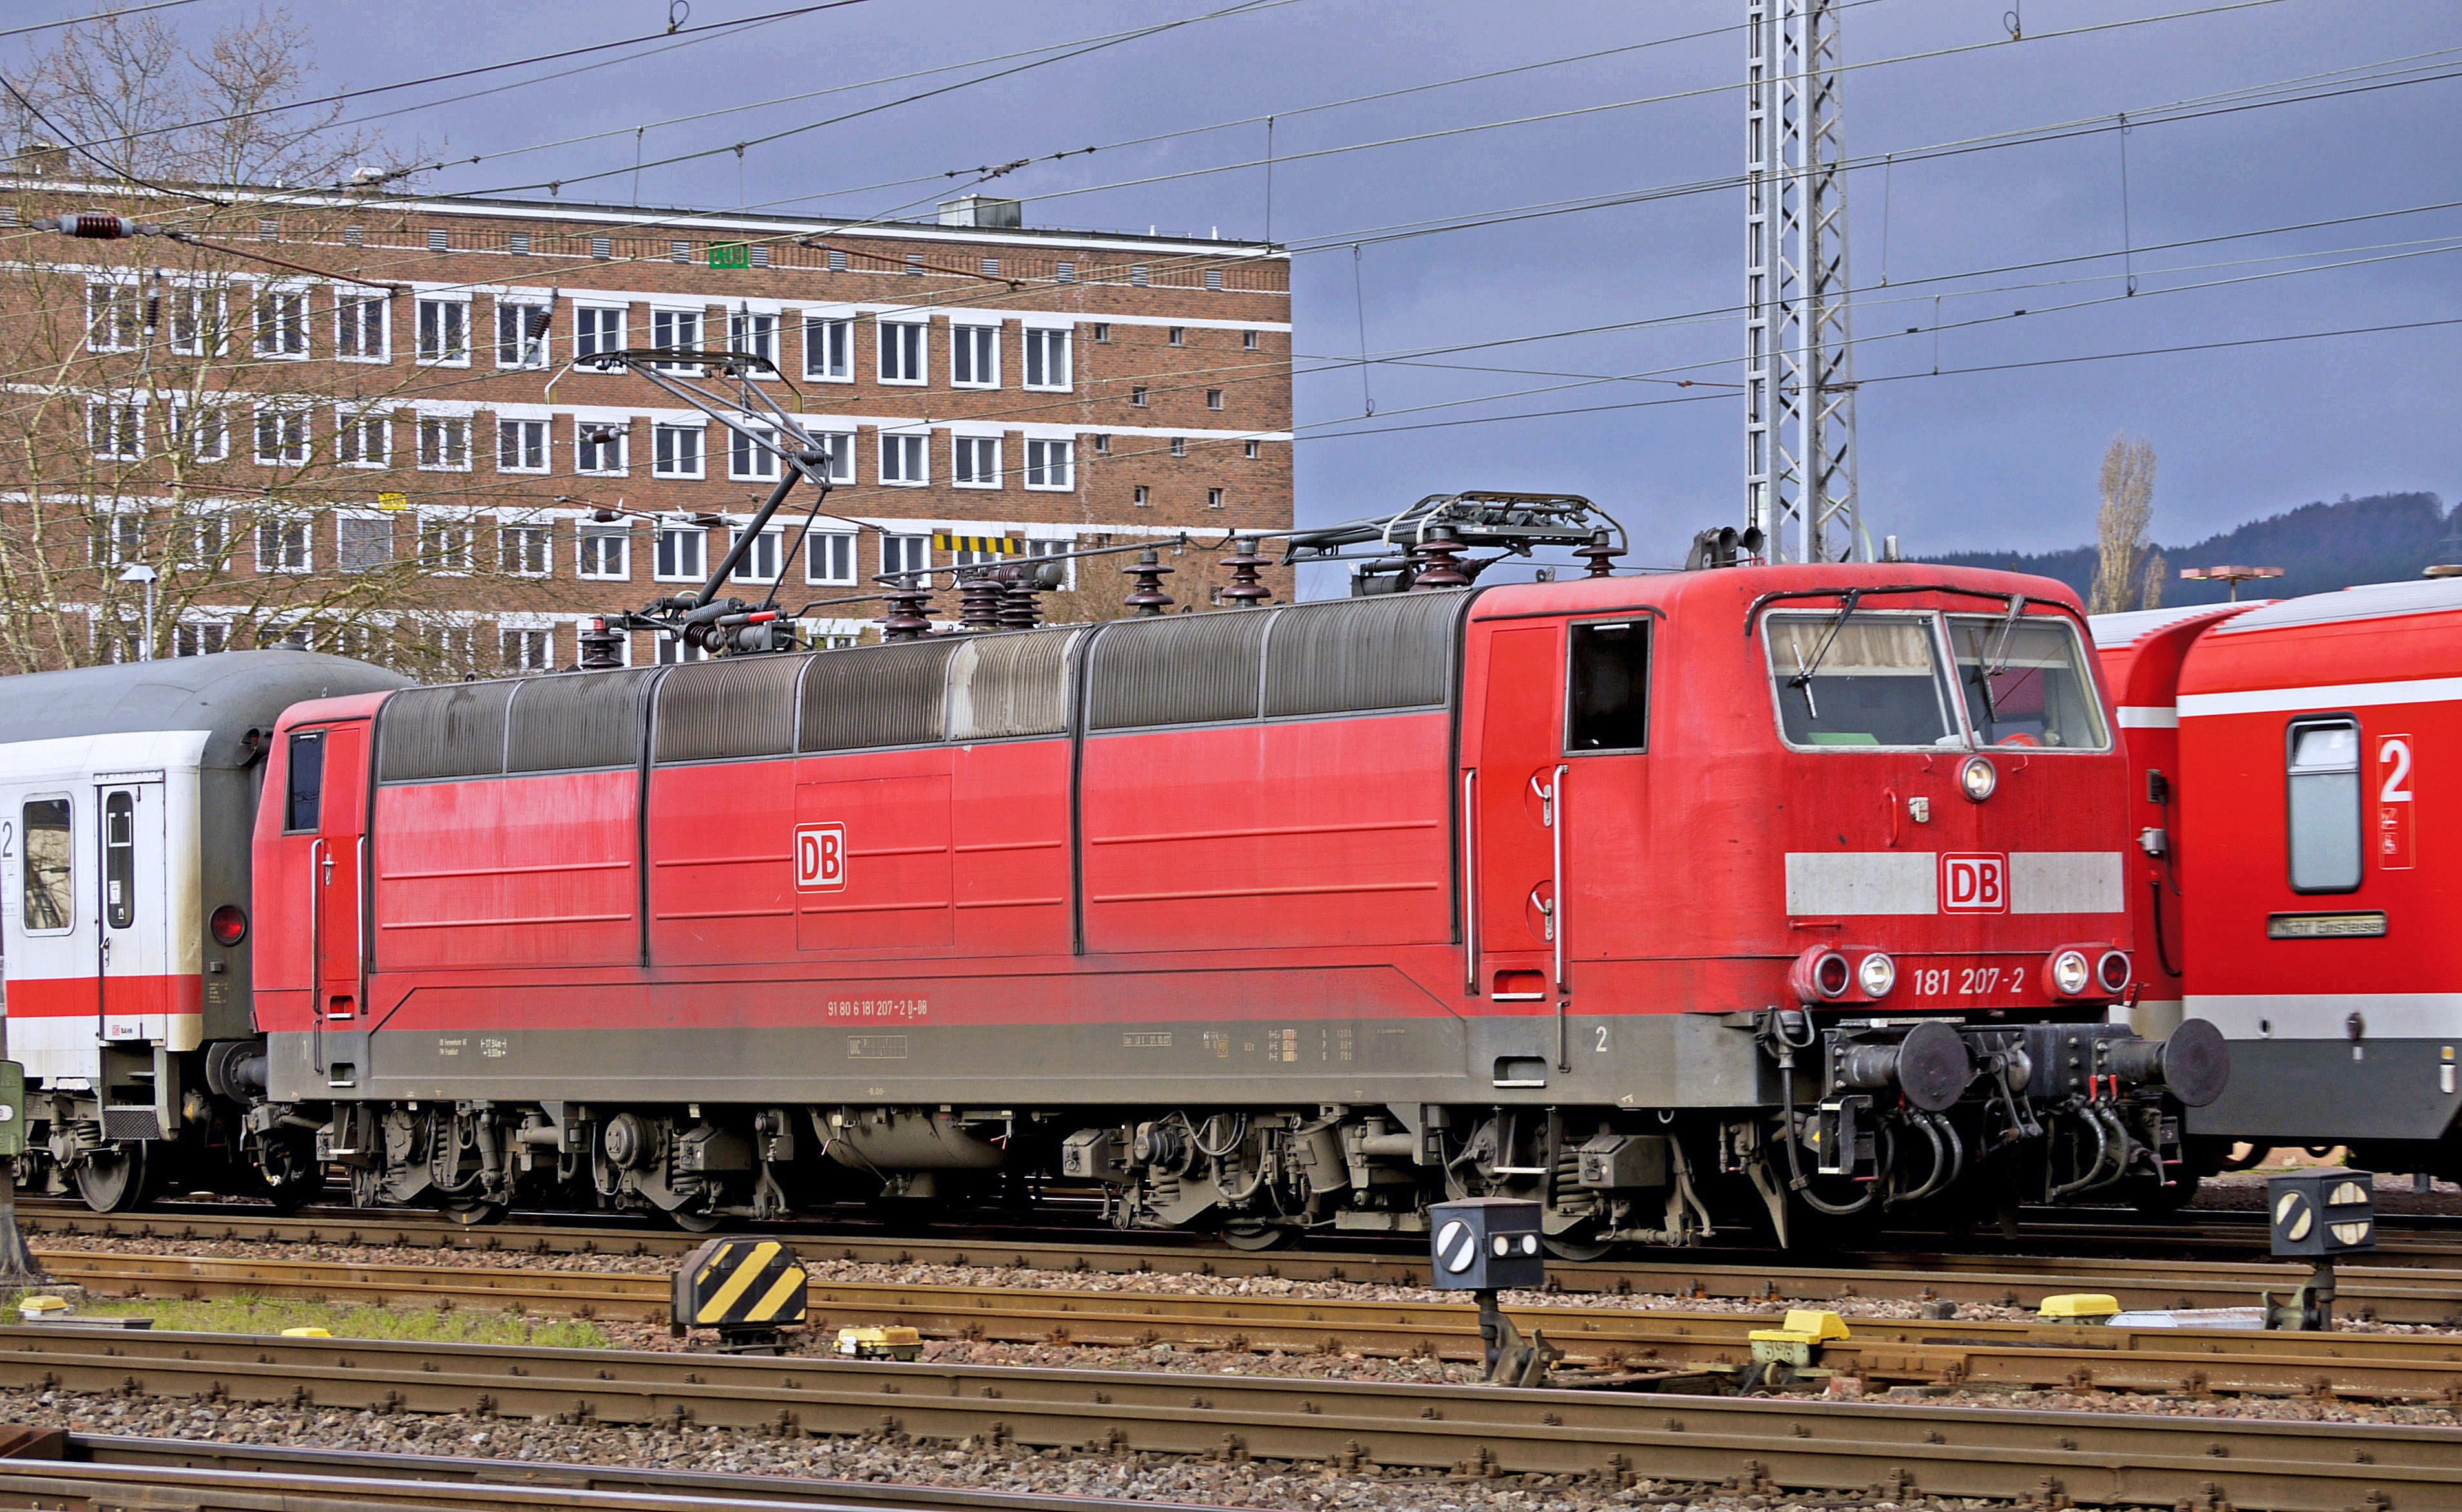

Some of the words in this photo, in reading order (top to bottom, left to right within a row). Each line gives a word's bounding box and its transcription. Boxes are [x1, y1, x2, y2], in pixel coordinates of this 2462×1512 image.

[2379, 739, 2412, 802] 2
[3, 821, 12, 857] 2
[801, 835, 840, 880] DB
[1952, 863, 1999, 902] DB
[1915, 969, 1950, 995] 181
[1959, 967, 2024, 994] 207-2
[828, 1002, 837, 1016] 91
[840, 1002, 850, 1016] 80
[853, 1002, 859, 1016] 6
[862, 1001, 874, 1015] 181
[303, 1040, 306, 1060] 1
[850, 1039, 861, 1055] UIC
[1595, 1026, 1607, 1052] 2
